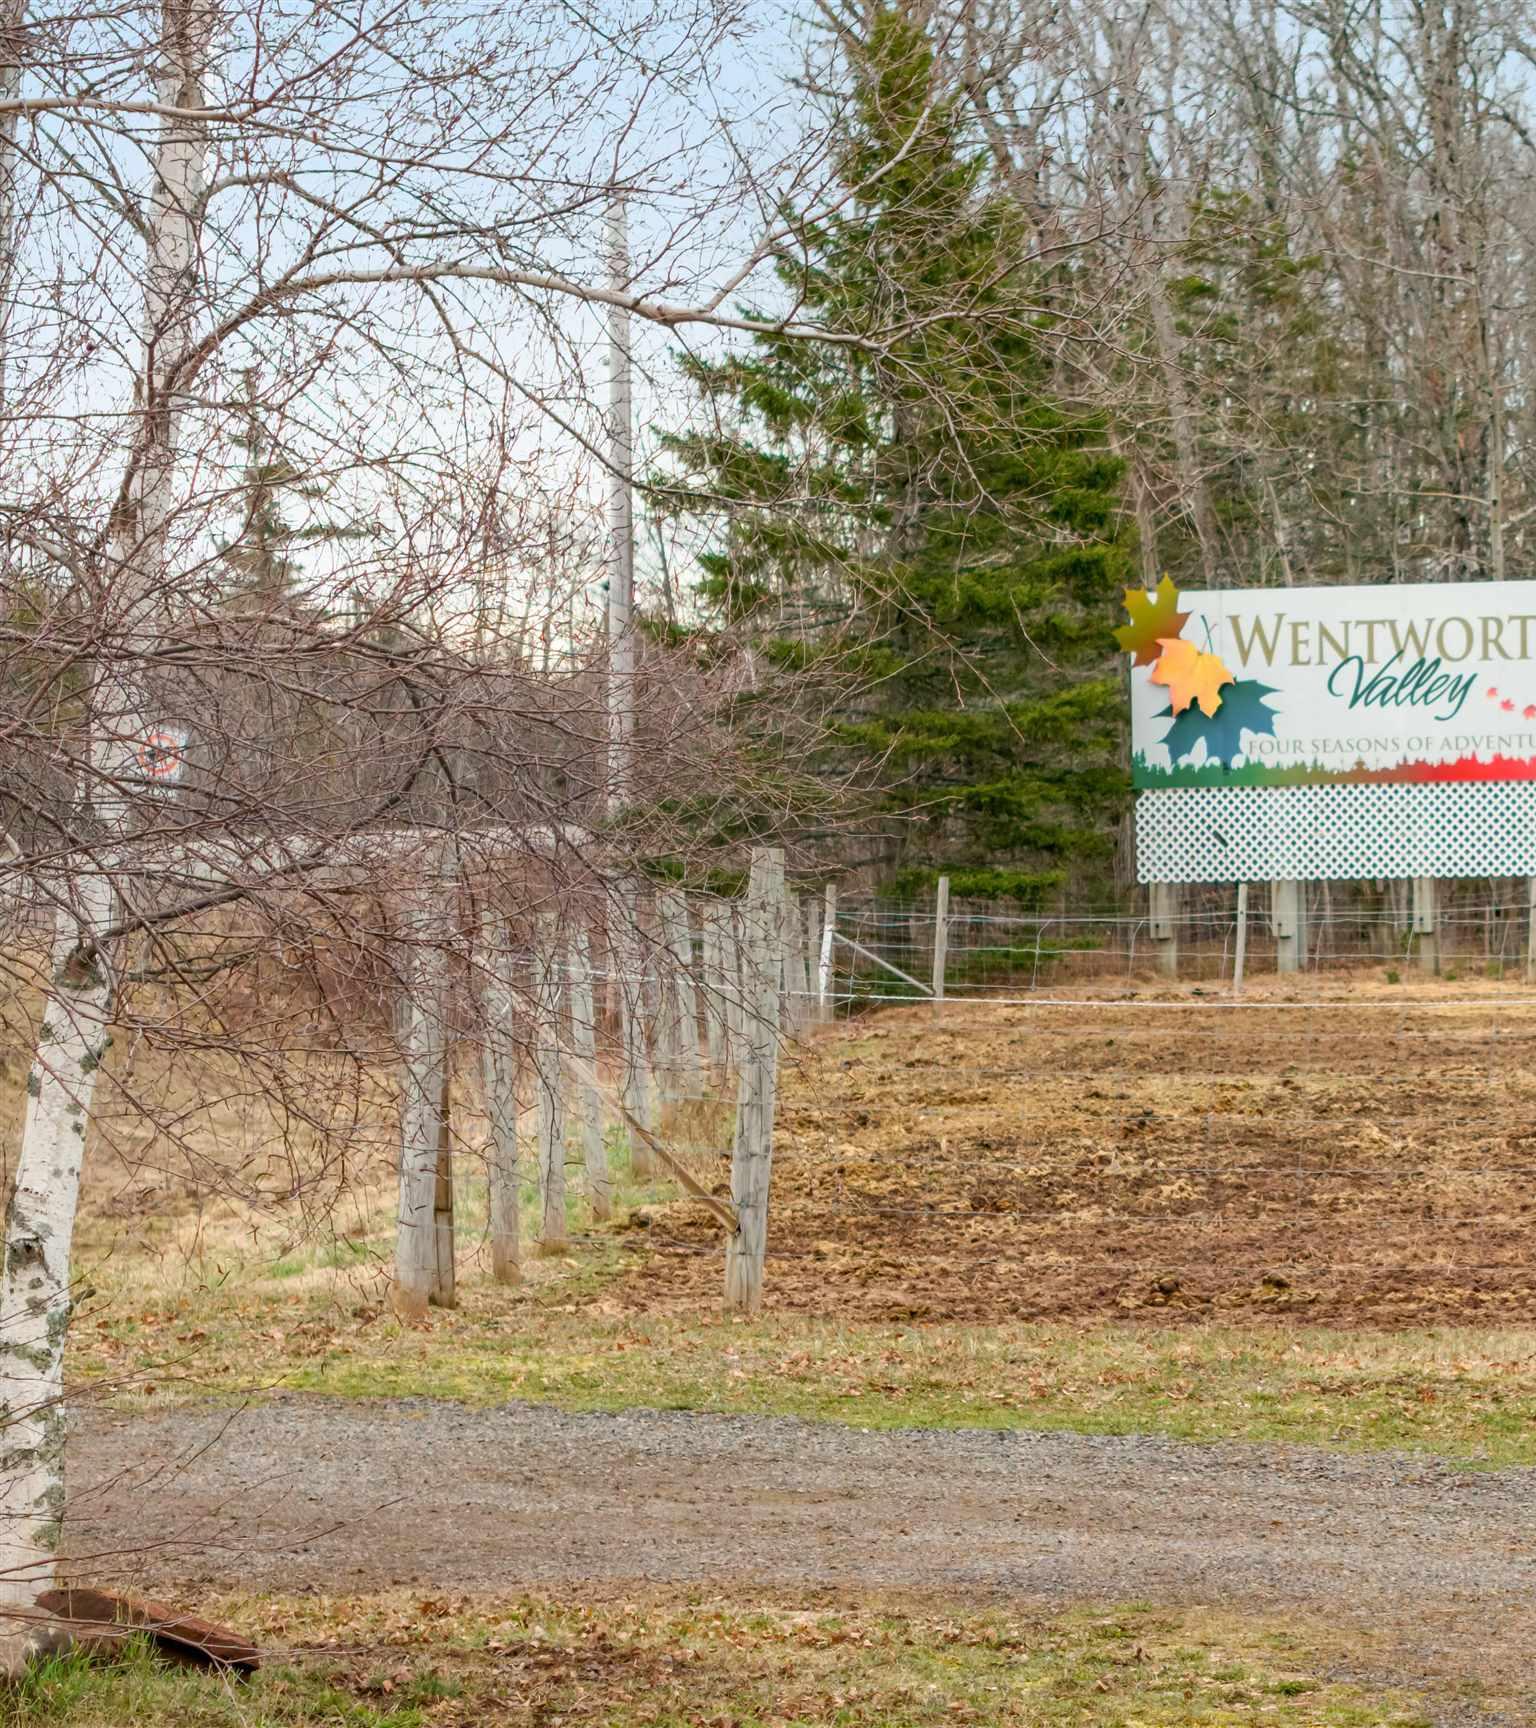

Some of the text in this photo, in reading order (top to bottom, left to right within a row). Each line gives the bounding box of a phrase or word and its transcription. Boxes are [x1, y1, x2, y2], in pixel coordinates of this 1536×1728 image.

[1327, 650, 1478, 721] Valley
[1249, 738, 1304, 755] FOUR
[1311, 736, 1400, 754] SEASONS
[1407, 735, 1433, 751] OF
